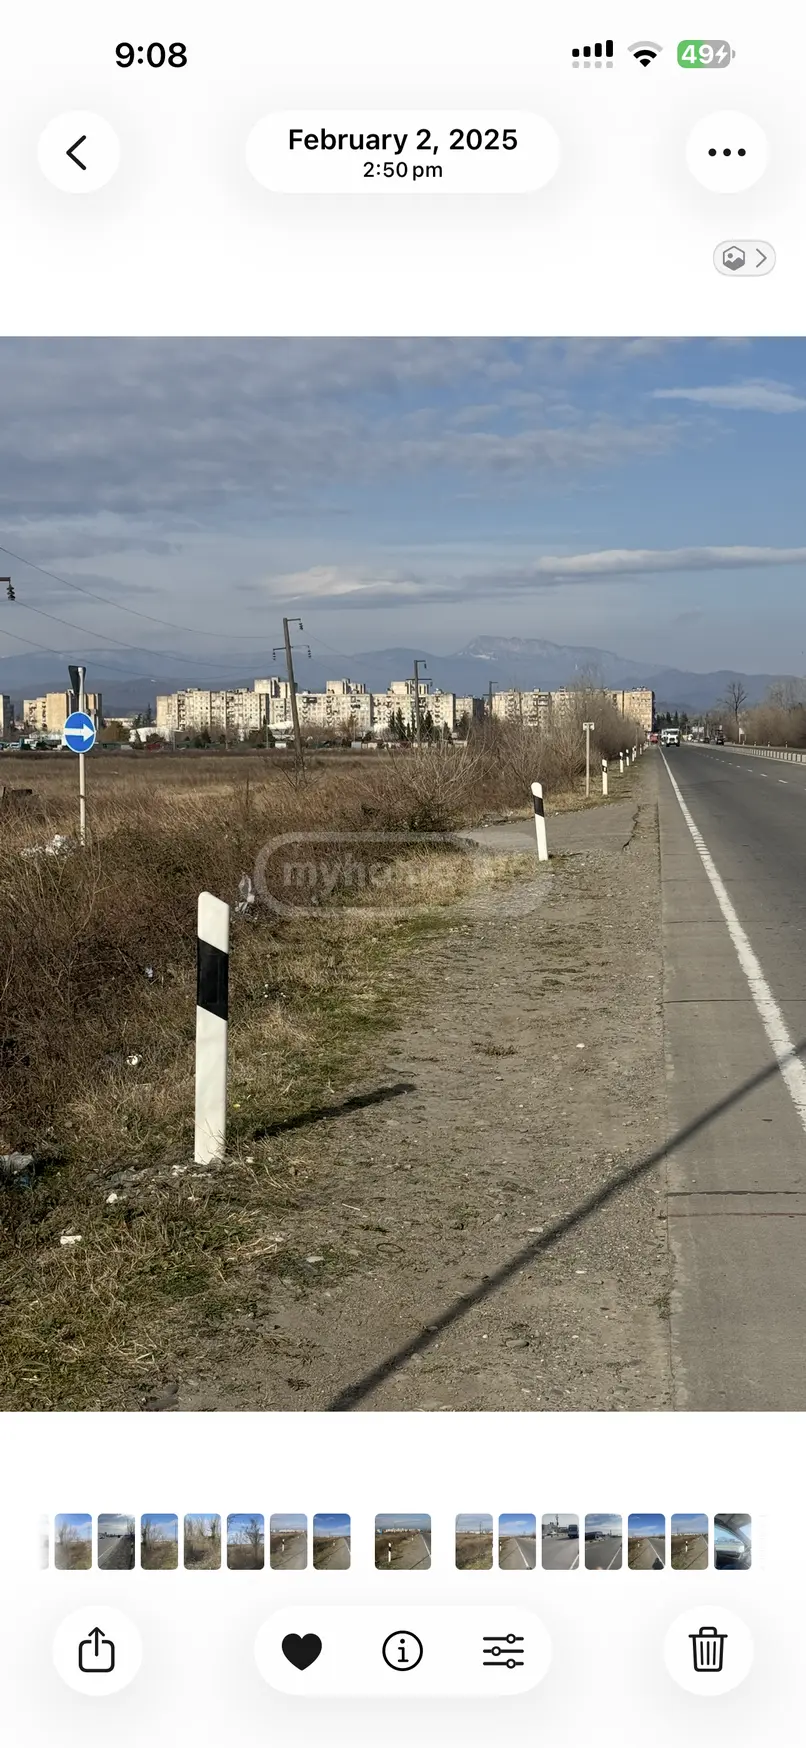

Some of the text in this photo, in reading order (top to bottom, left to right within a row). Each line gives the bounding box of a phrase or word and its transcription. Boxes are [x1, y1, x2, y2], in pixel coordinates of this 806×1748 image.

[115, 42, 188, 68] 9:08
[681, 44, 714, 65] 49
[288, 127, 518, 156] February 2, 2025
[363, 161, 443, 182] 2:50 pm
